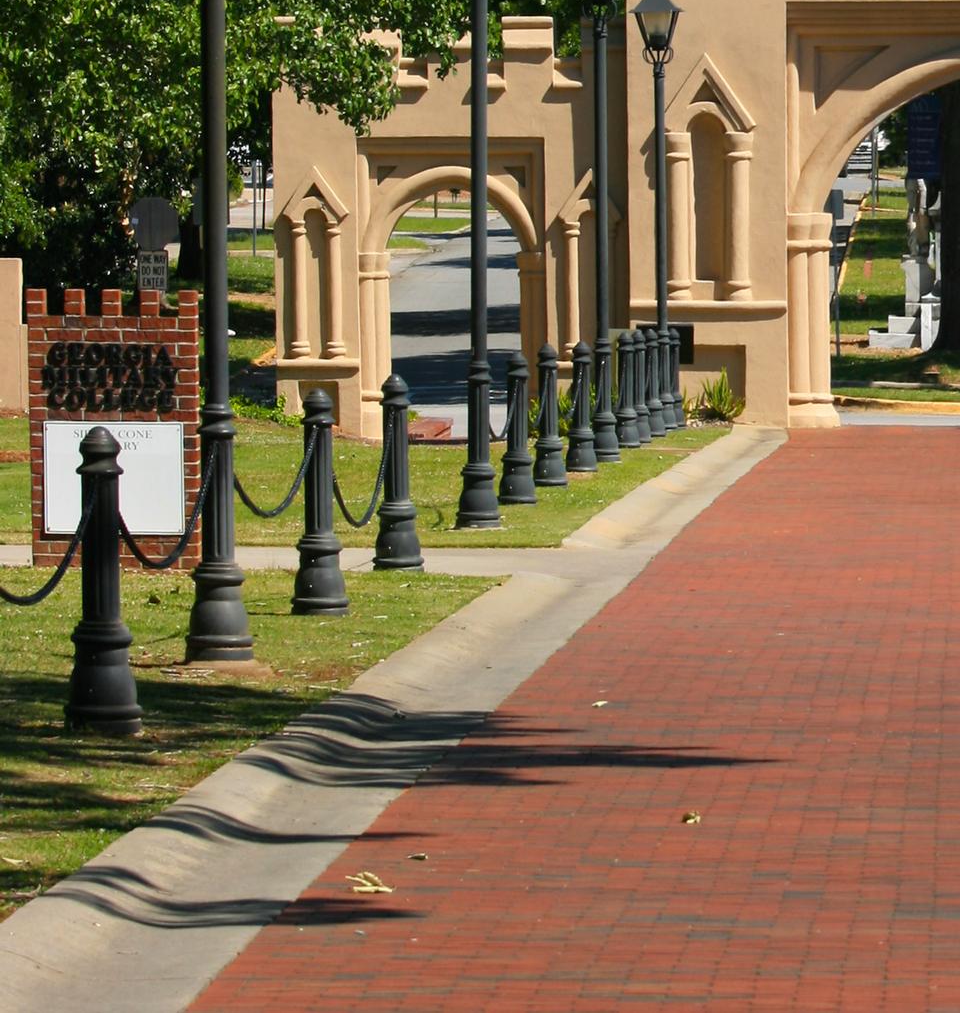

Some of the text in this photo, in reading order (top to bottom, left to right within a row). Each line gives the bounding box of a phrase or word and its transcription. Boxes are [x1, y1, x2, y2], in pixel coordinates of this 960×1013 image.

[140, 254, 166, 265] ONE WAY
[141, 266, 165, 276] DO NOT
[142, 277, 165, 288] ENTER
[47, 342, 172, 366] GEORGIA
[42, 365, 178, 389] MILITARY
[47, 387, 174, 412] COLLEGE
[118, 429, 153, 439] CONE
